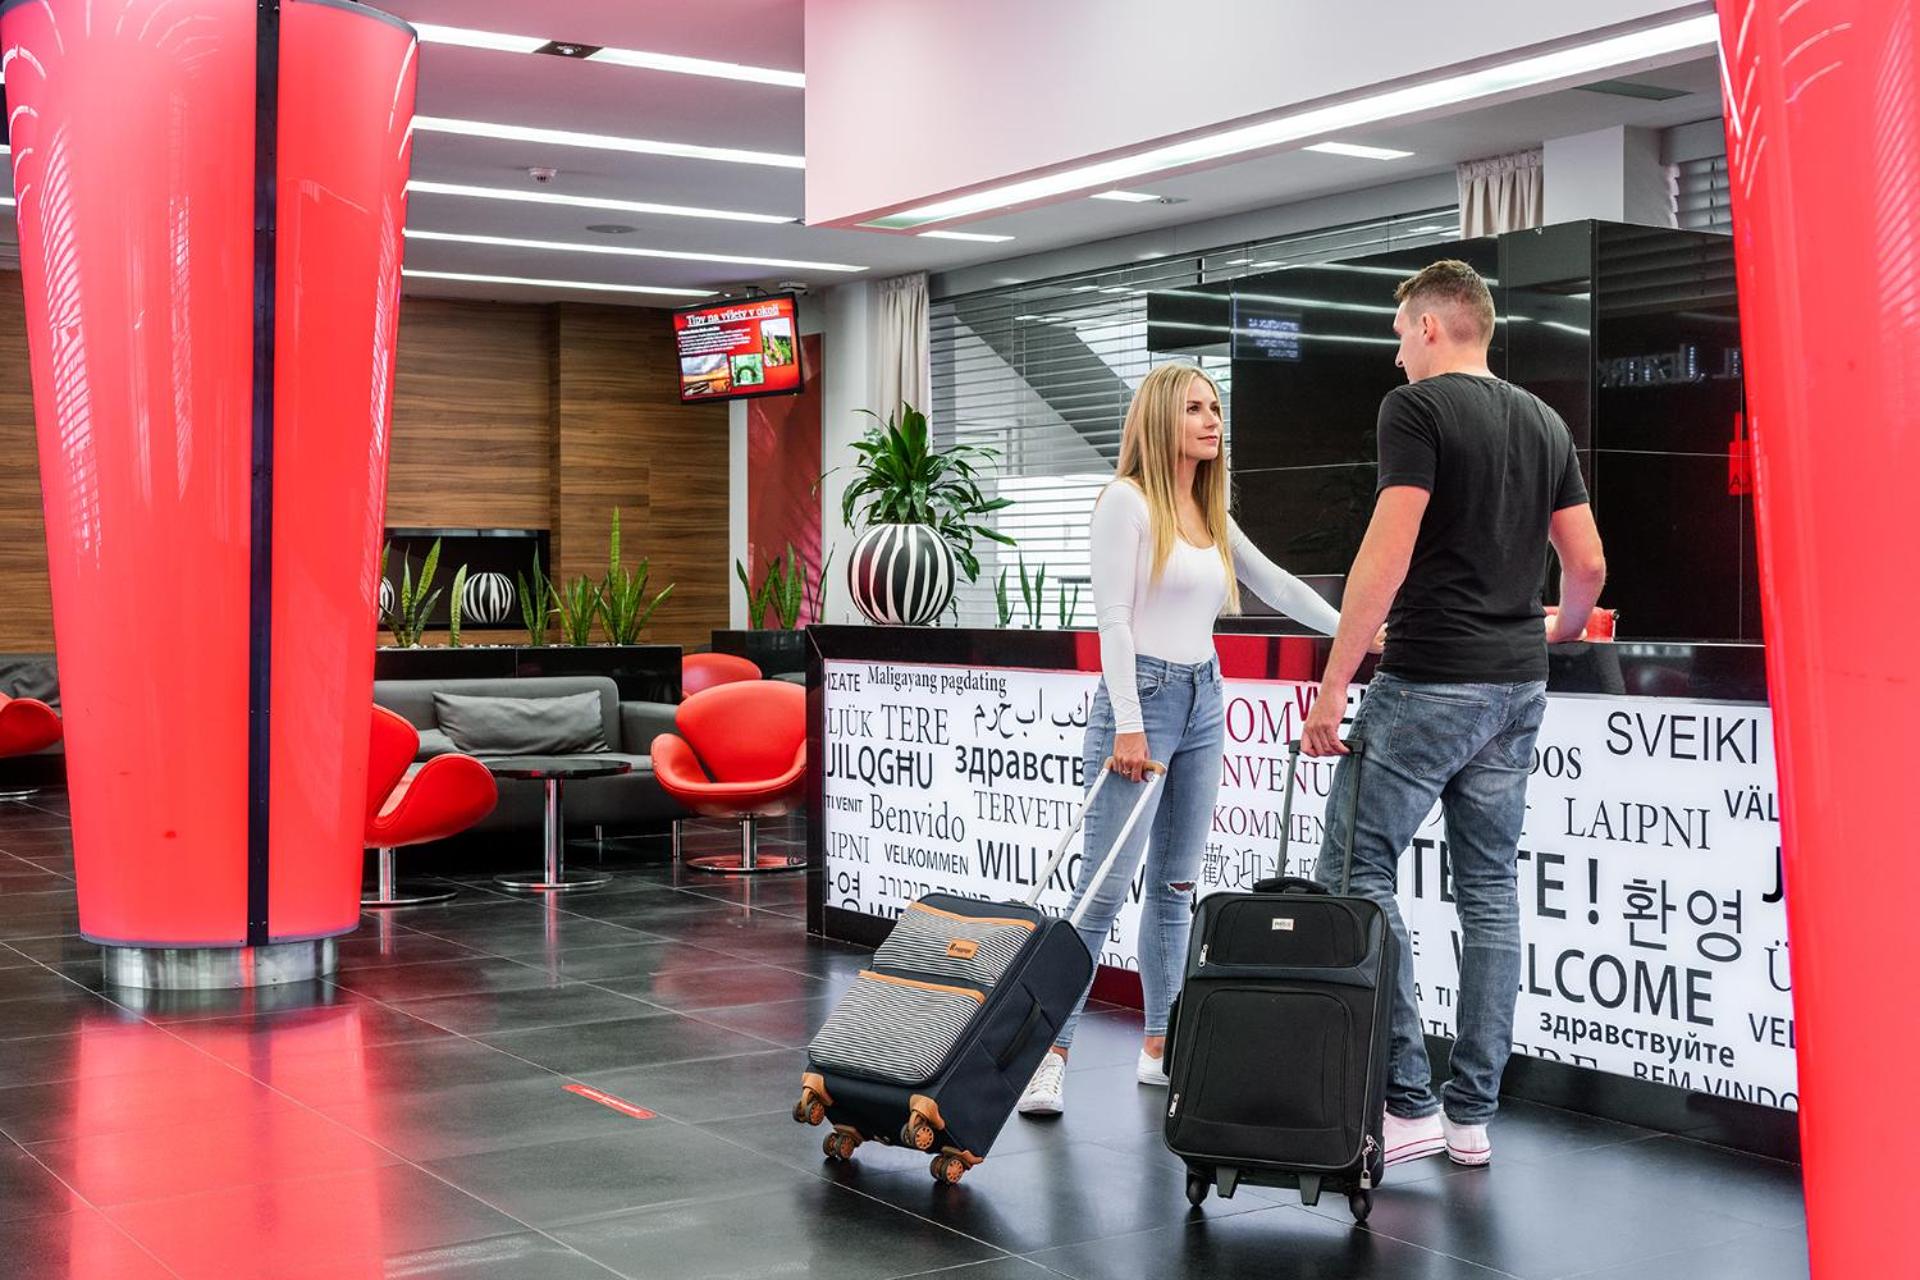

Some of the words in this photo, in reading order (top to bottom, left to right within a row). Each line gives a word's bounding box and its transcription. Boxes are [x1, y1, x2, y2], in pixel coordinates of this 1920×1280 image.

[824, 672, 861, 692] ΙΣΑΤΕ
[867, 666, 938, 694] Maligayang
[940, 670, 1007, 698] pagdating
[881, 703, 950, 746] TERE
[1606, 710, 1758, 765] SVEIKI
[836, 796, 863, 813] VENIT
[870, 793, 965, 843] Benvido
[1564, 797, 1711, 850] LAIPNI
[826, 831, 870, 864] IPNI
[884, 843, 969, 875] VELKOMMEN
[1622, 877, 1743, 963] 환영
[1539, 1012, 1735, 1068] здравствуйте
